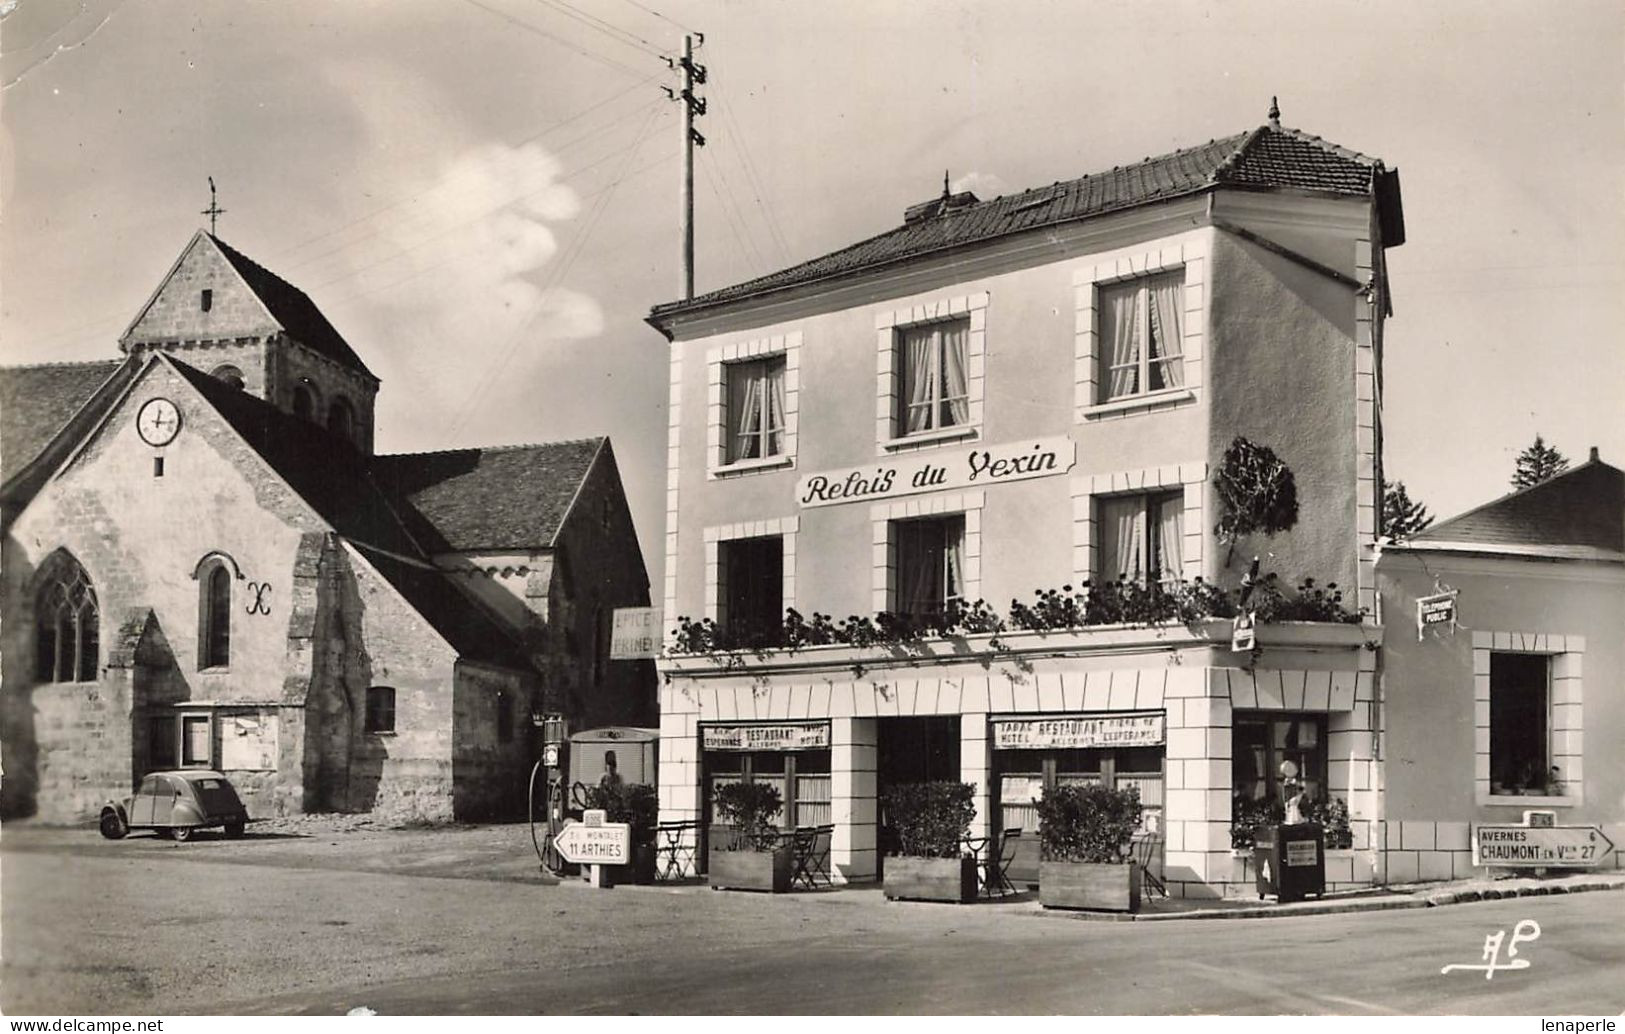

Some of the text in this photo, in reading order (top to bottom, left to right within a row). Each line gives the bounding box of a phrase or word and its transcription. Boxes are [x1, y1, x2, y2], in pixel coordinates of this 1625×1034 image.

[802, 444, 1058, 504] Relais du Vexin
[1001, 722, 1033, 733] TABAC
[1039, 720, 1104, 736] RESTAURANT
[800, 735, 824, 745] HOTEL
[1001, 734, 1030, 743] HOTEL
[1481, 831, 1596, 842] AVERNES 6
[569, 843, 622, 857] 11 ARTHIES
[1480, 845, 1540, 860] CHAUMONT
[1581, 845, 1597, 859] 27
